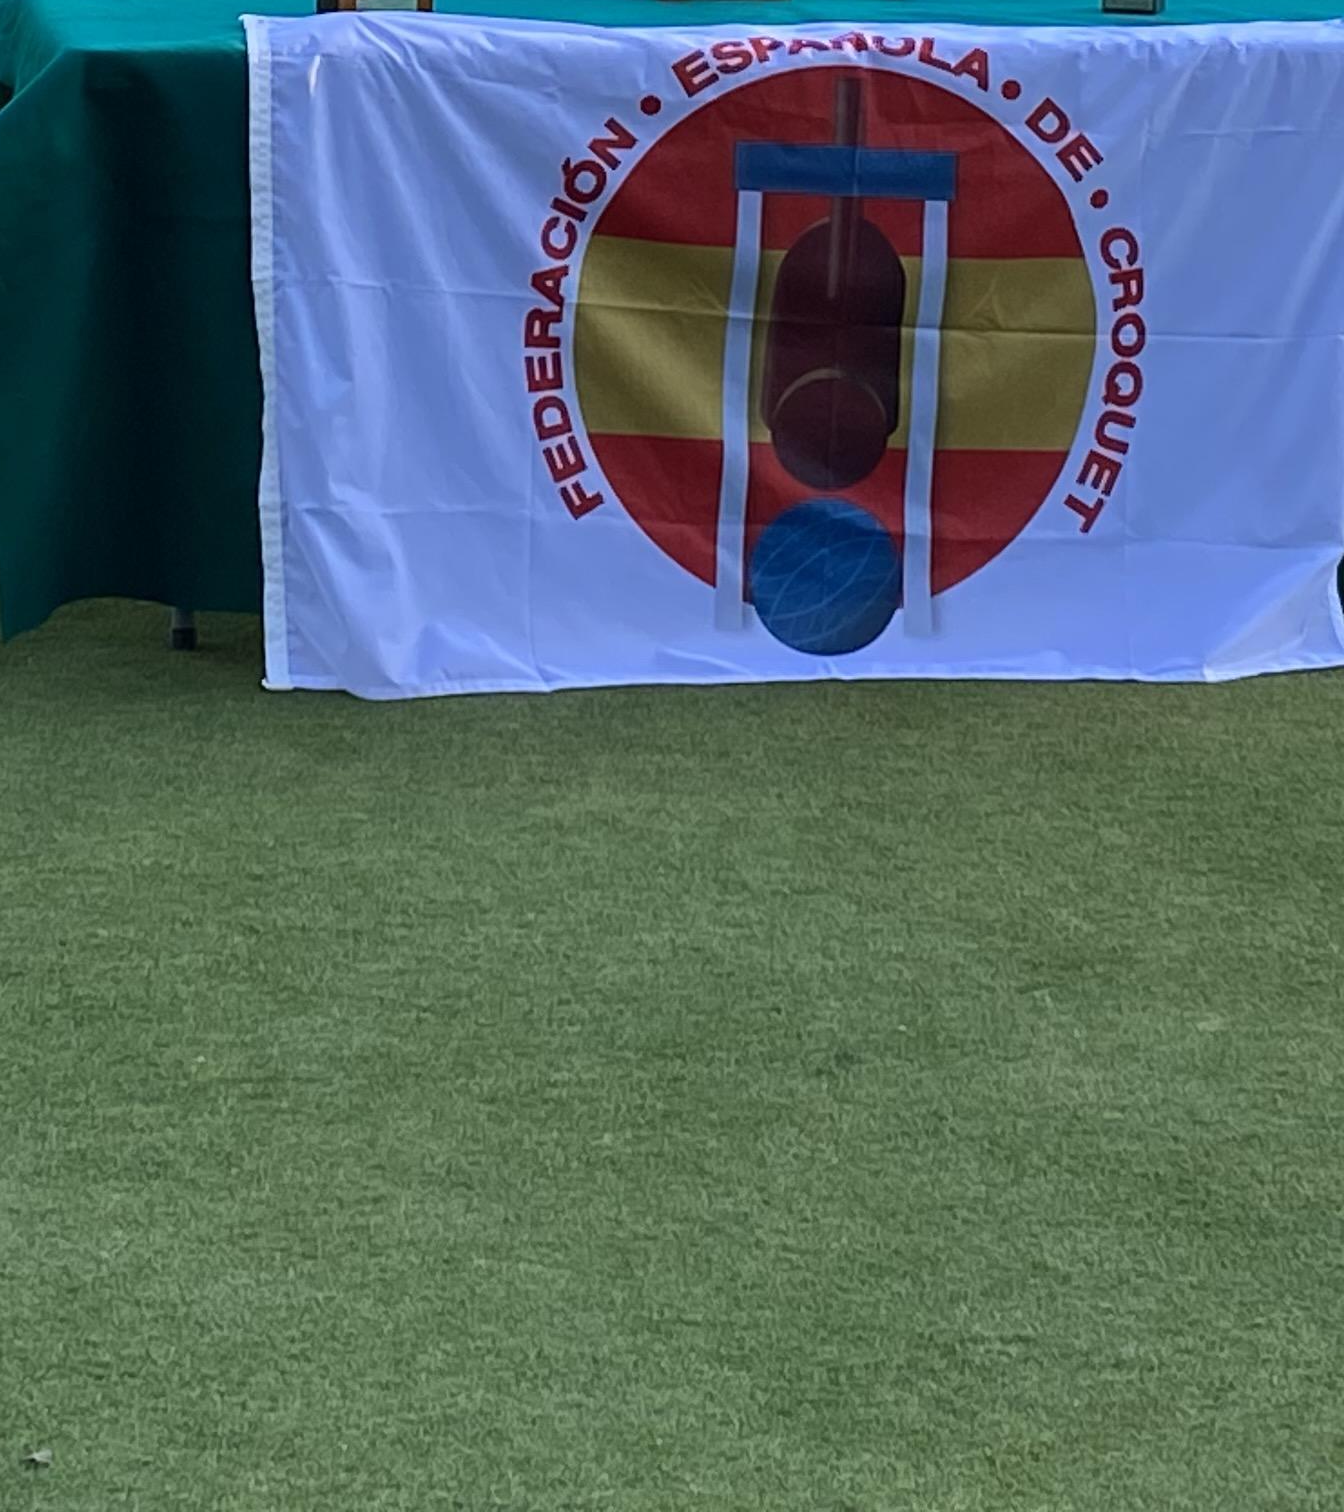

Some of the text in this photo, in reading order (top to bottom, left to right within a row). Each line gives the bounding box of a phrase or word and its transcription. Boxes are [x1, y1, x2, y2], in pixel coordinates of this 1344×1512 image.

[1026, 97, 1105, 182] DE
[523, 118, 639, 520] FEDERACIÓN
[1063, 227, 1146, 533] CROQUET
